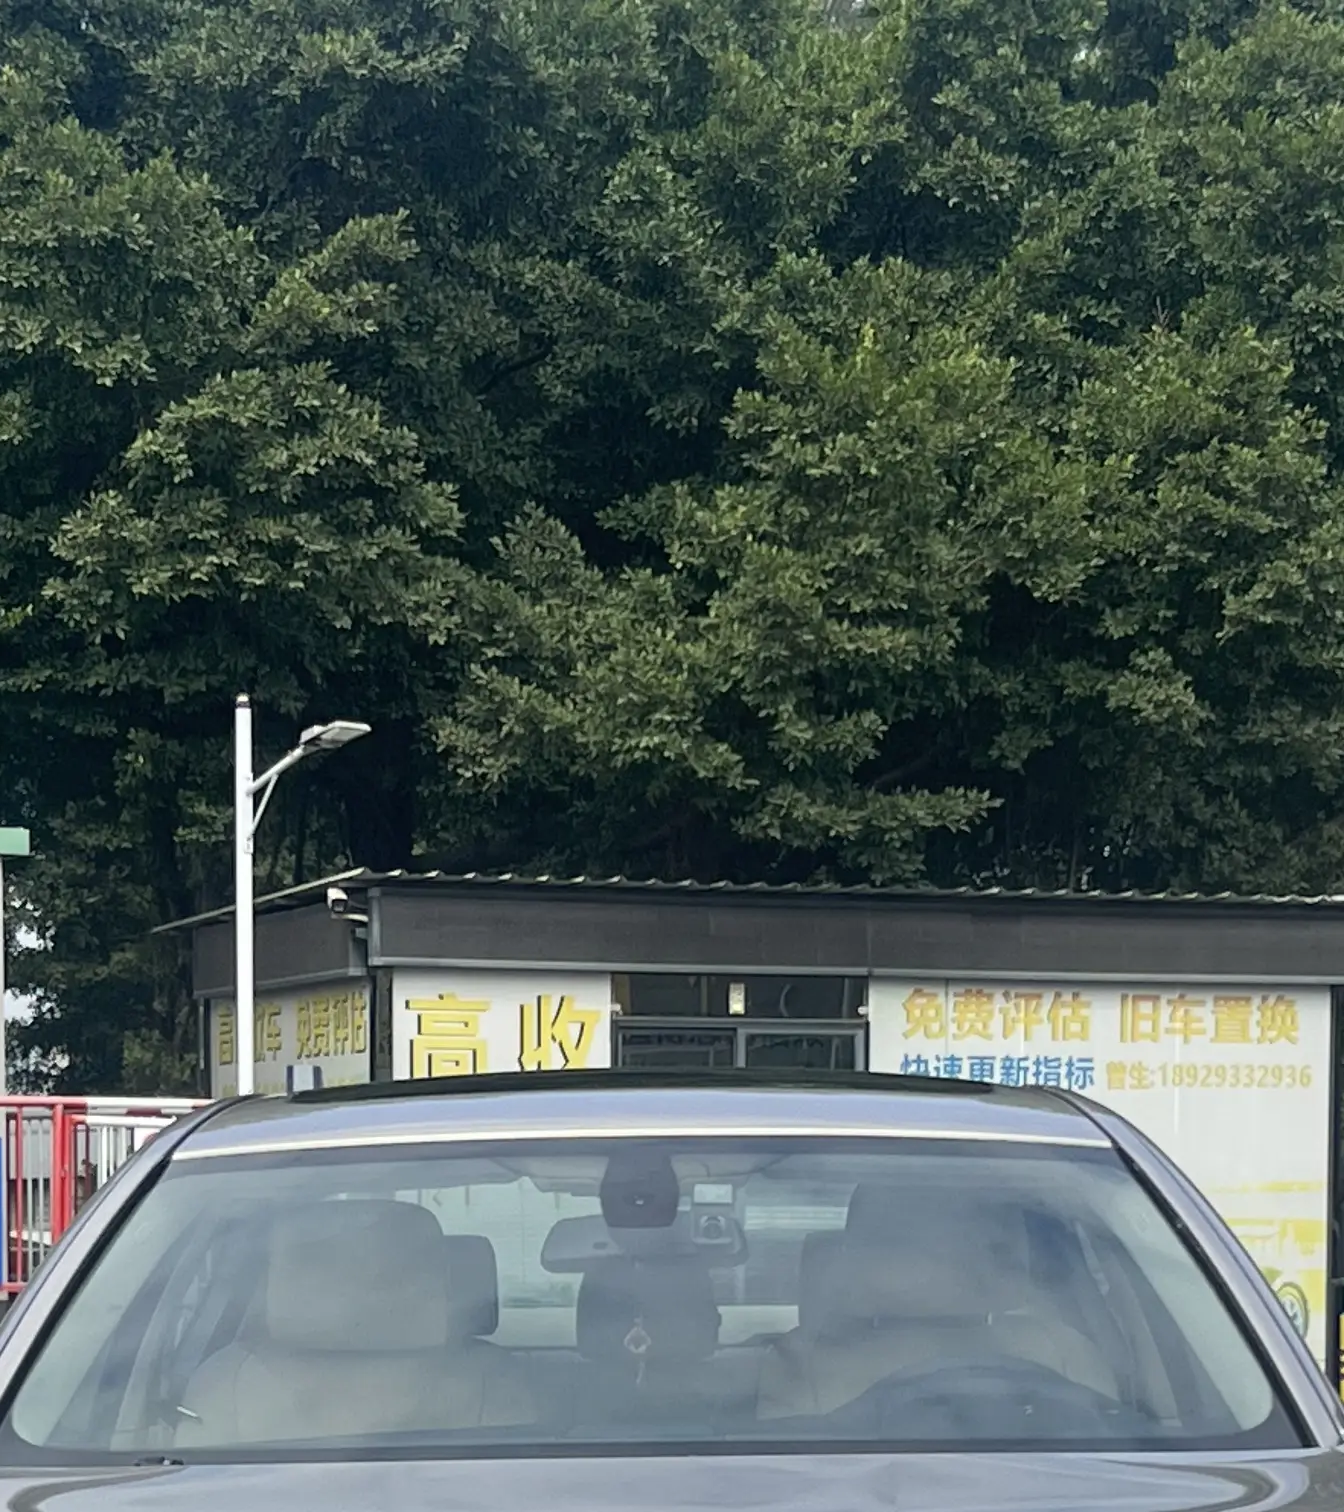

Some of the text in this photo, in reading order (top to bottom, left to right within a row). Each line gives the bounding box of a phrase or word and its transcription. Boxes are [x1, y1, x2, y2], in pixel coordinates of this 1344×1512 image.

[901, 986, 1301, 1046] 免费评估 旧车置换
[899, 1052, 1095, 1091] 快速更新指标
